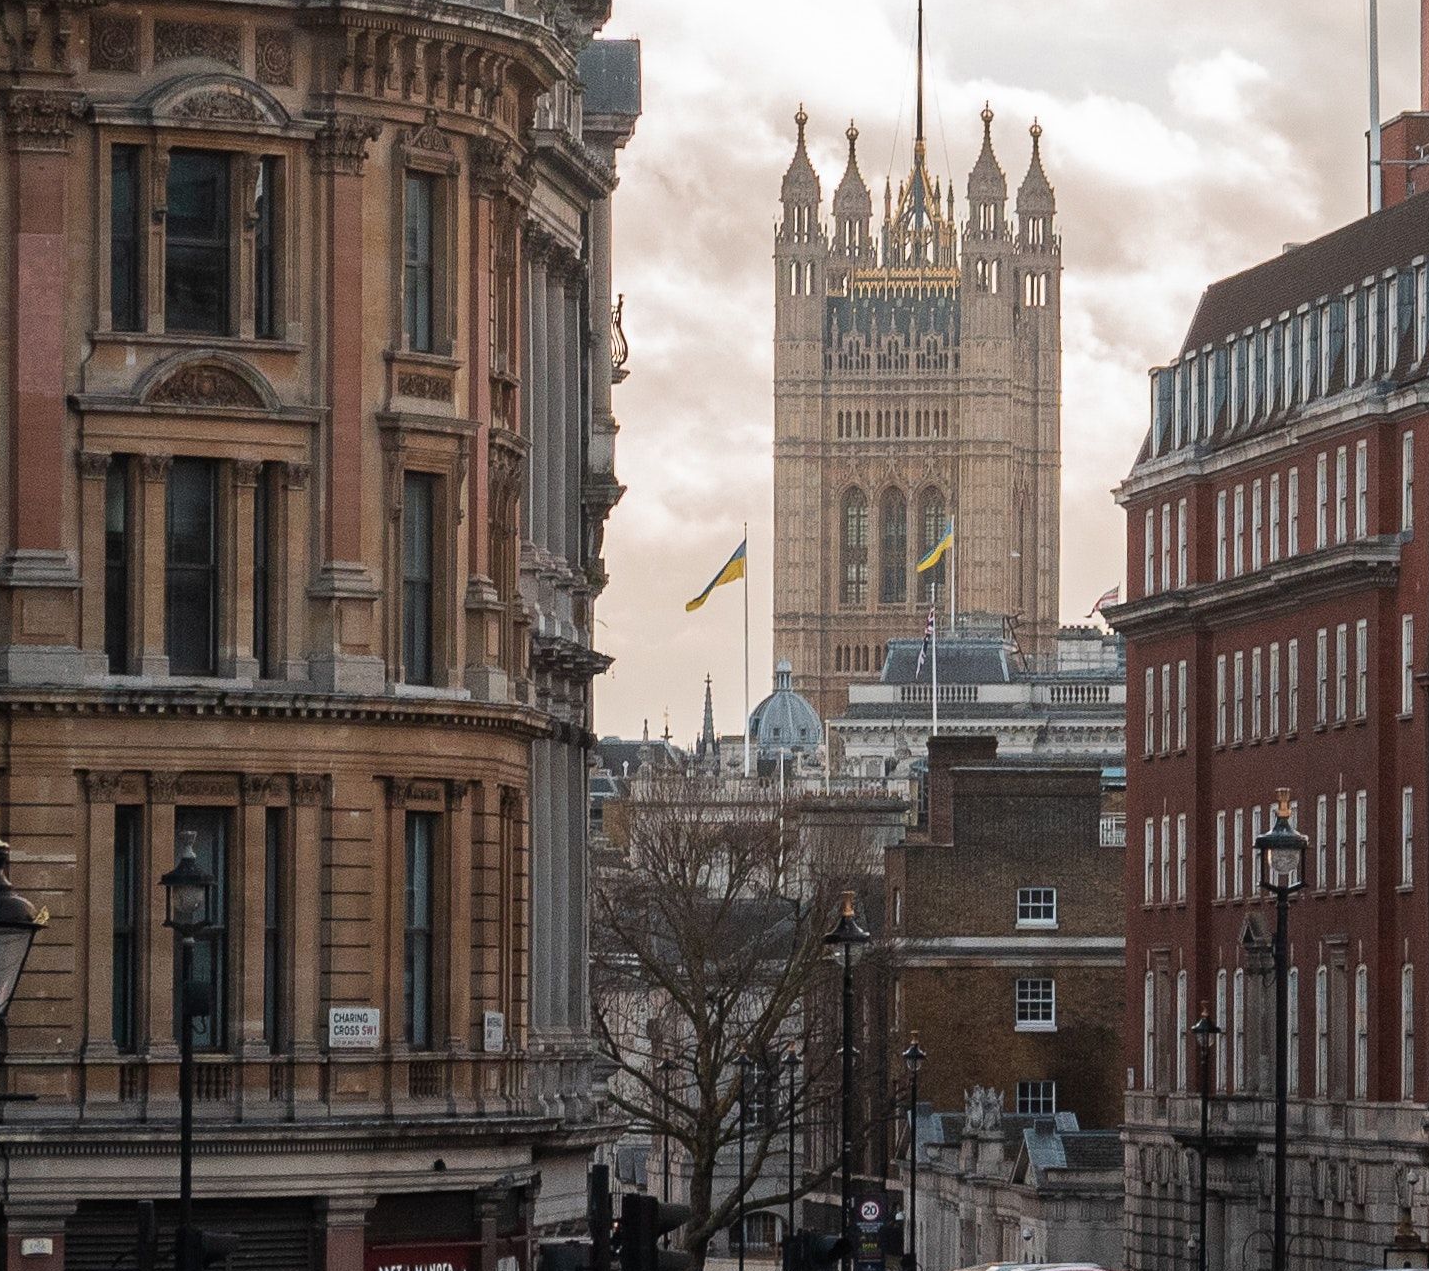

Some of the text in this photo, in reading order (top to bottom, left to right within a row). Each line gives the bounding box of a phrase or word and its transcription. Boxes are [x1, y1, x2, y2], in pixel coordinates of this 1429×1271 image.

[333, 1013, 368, 1023] CHARING
[333, 1025, 377, 1036] CROSS SW1
[863, 1205, 876, 1216] 20
